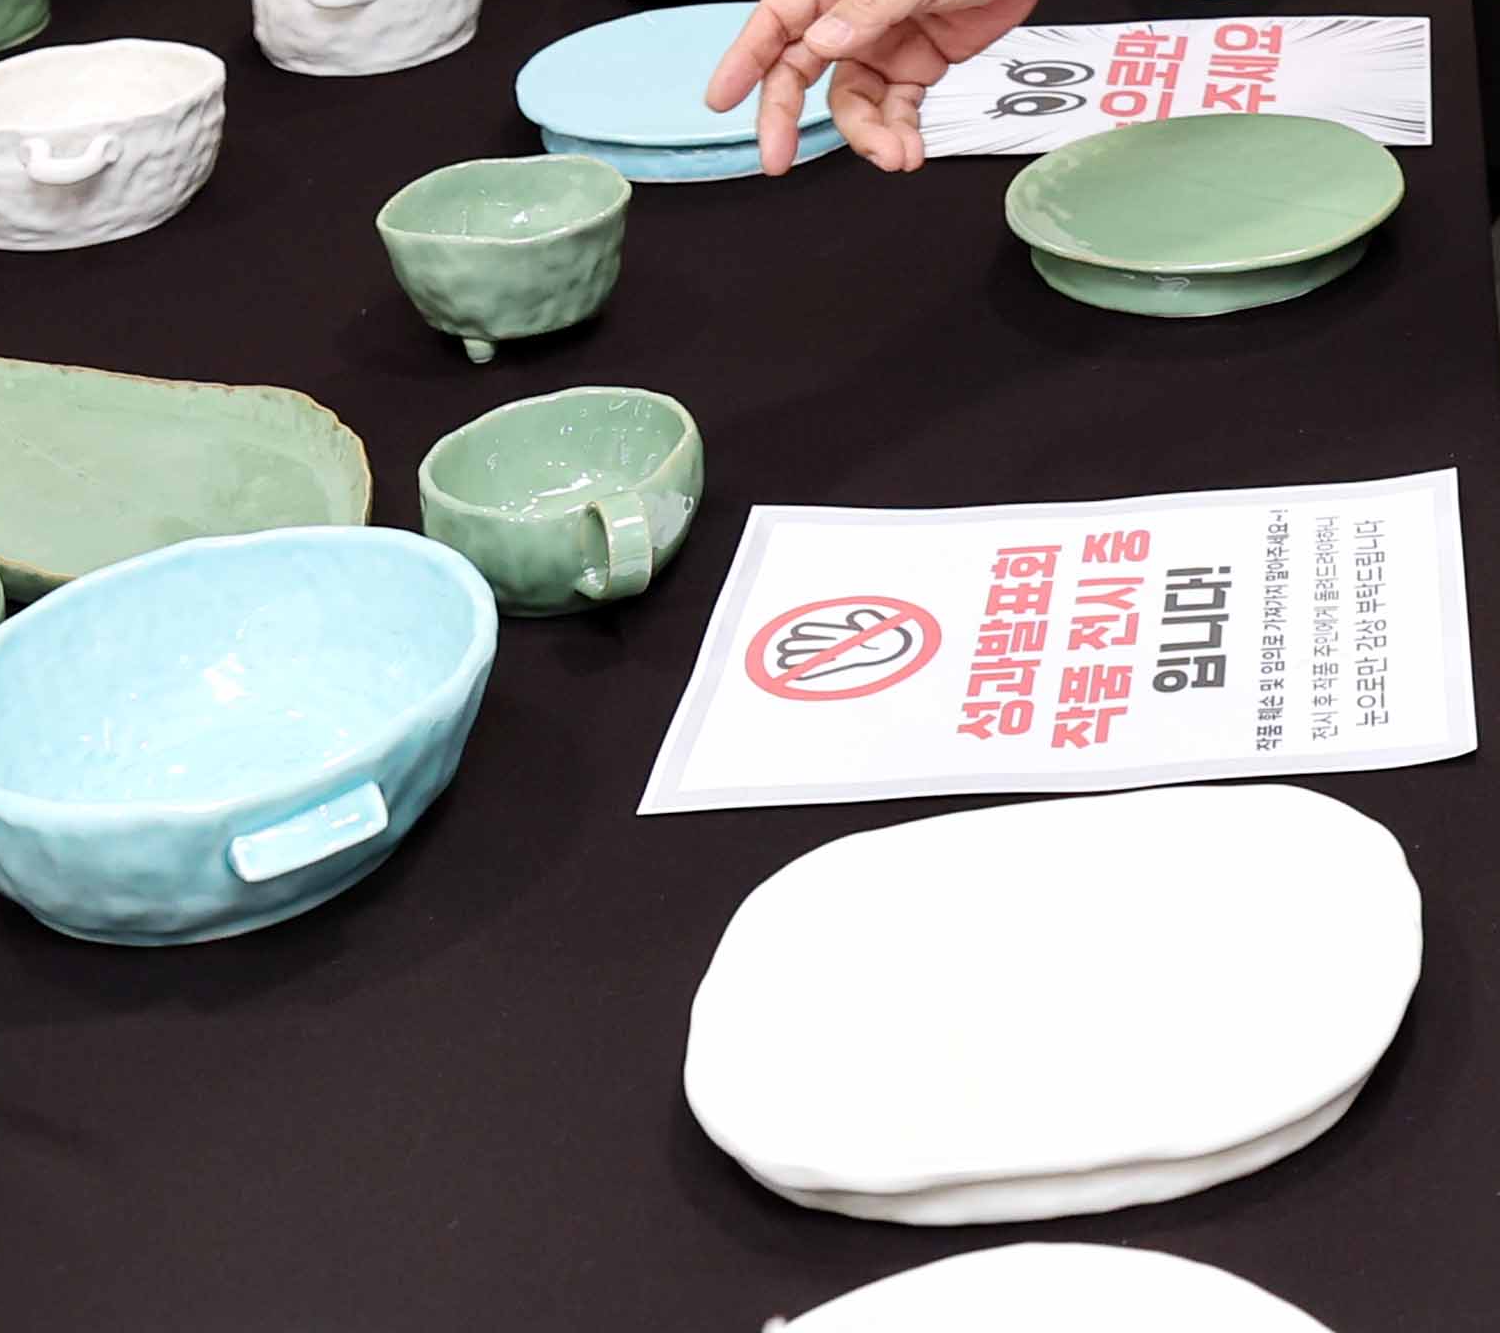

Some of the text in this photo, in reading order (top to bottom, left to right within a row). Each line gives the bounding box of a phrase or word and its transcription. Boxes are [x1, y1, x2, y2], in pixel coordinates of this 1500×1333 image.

[1100, 30, 1188, 128] 으로만
[1201, 23, 1284, 114] 주세요
[1152, 566, 1232, 693] 입니다!
[1262, 584, 1287, 631] 가져가지
[1354, 520, 1389, 727] 눈으로만 감상 부탁드립니다
[957, 544, 1062, 741] 성과발표회
[1051, 529, 1151, 749] 작품 전시 중
[1260, 634, 1286, 674] 임의로
[1313, 606, 1340, 657] 주인에게
[1260, 678, 1285, 692] 및
[1312, 662, 1339, 691] 작품
[1312, 693, 1336, 707] 후
[1258, 695, 1284, 721] 훼손
[1311, 712, 1339, 740] 전시
[1257, 724, 1283, 751] 작품
